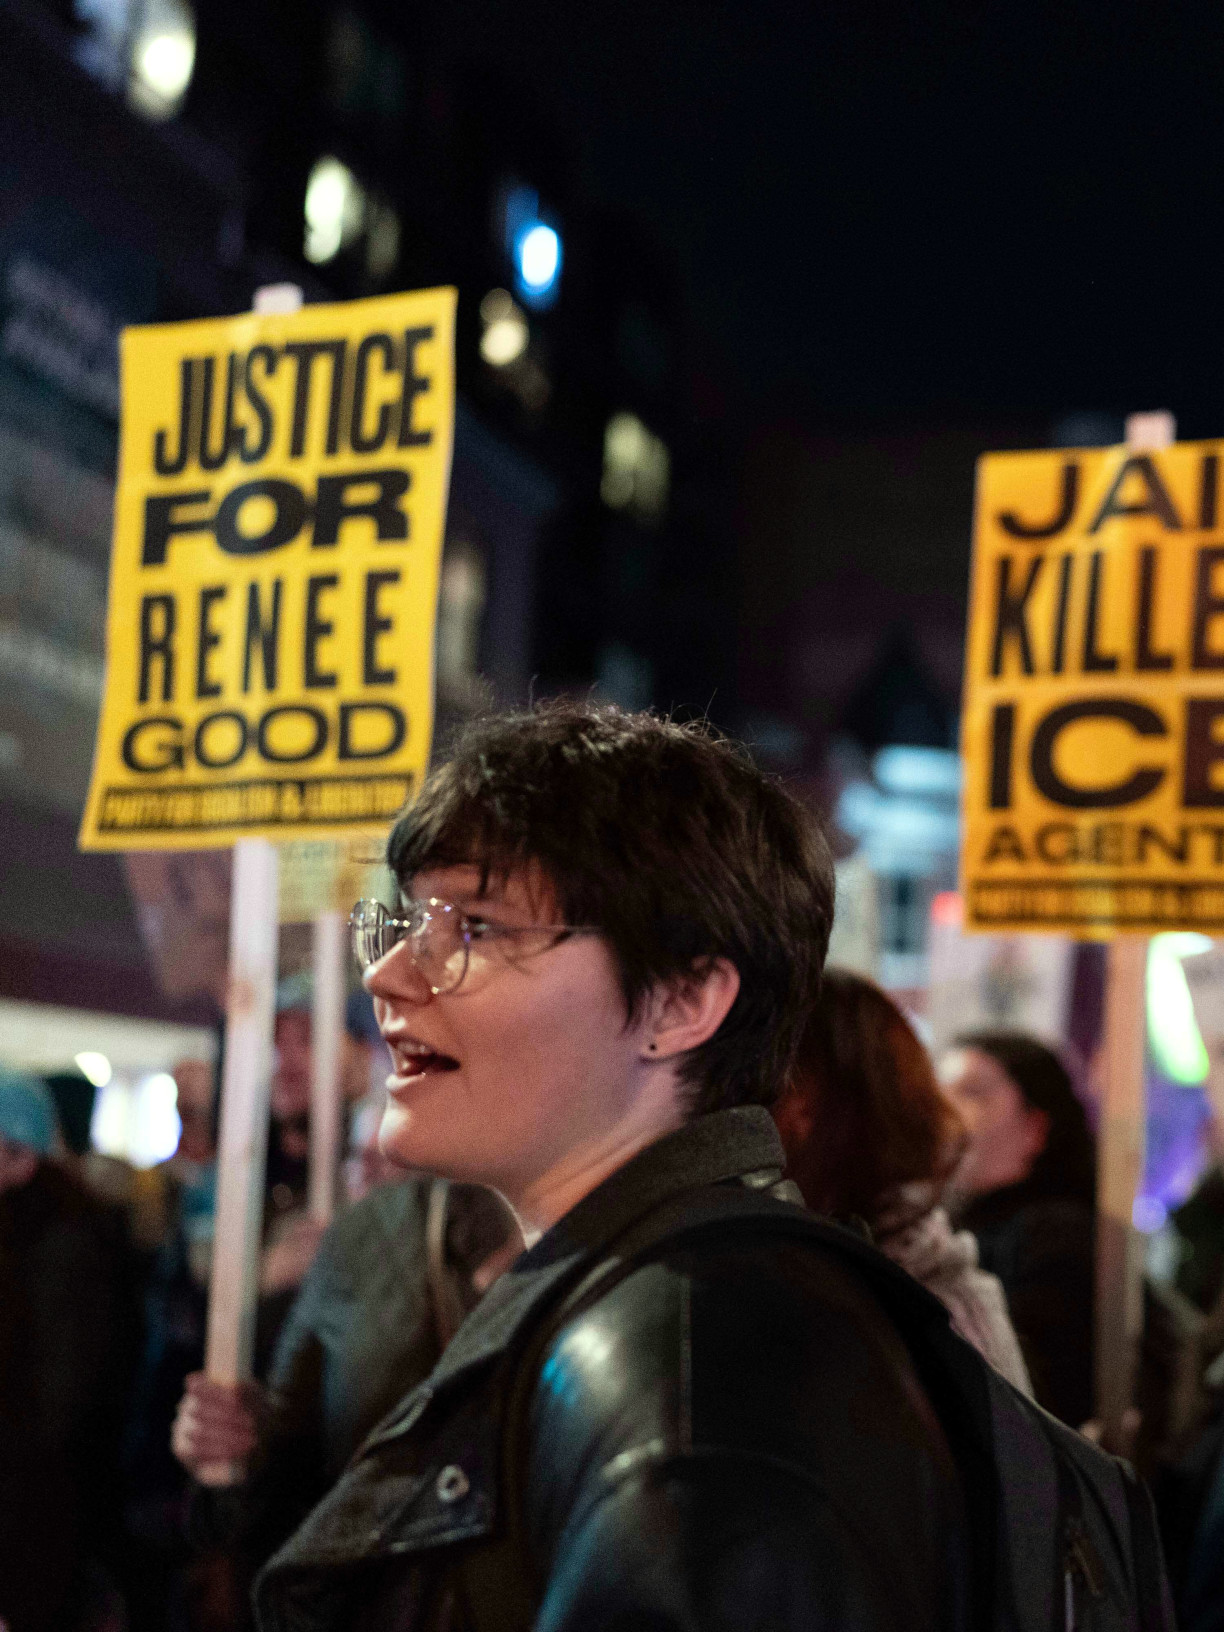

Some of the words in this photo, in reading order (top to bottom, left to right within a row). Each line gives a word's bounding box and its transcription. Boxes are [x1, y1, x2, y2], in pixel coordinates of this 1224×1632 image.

[153, 326, 436, 476] JUSTICE
[140, 469, 410, 567] FOR
[139, 570, 402, 703] RENEE
[120, 703, 409, 775] GOOD
